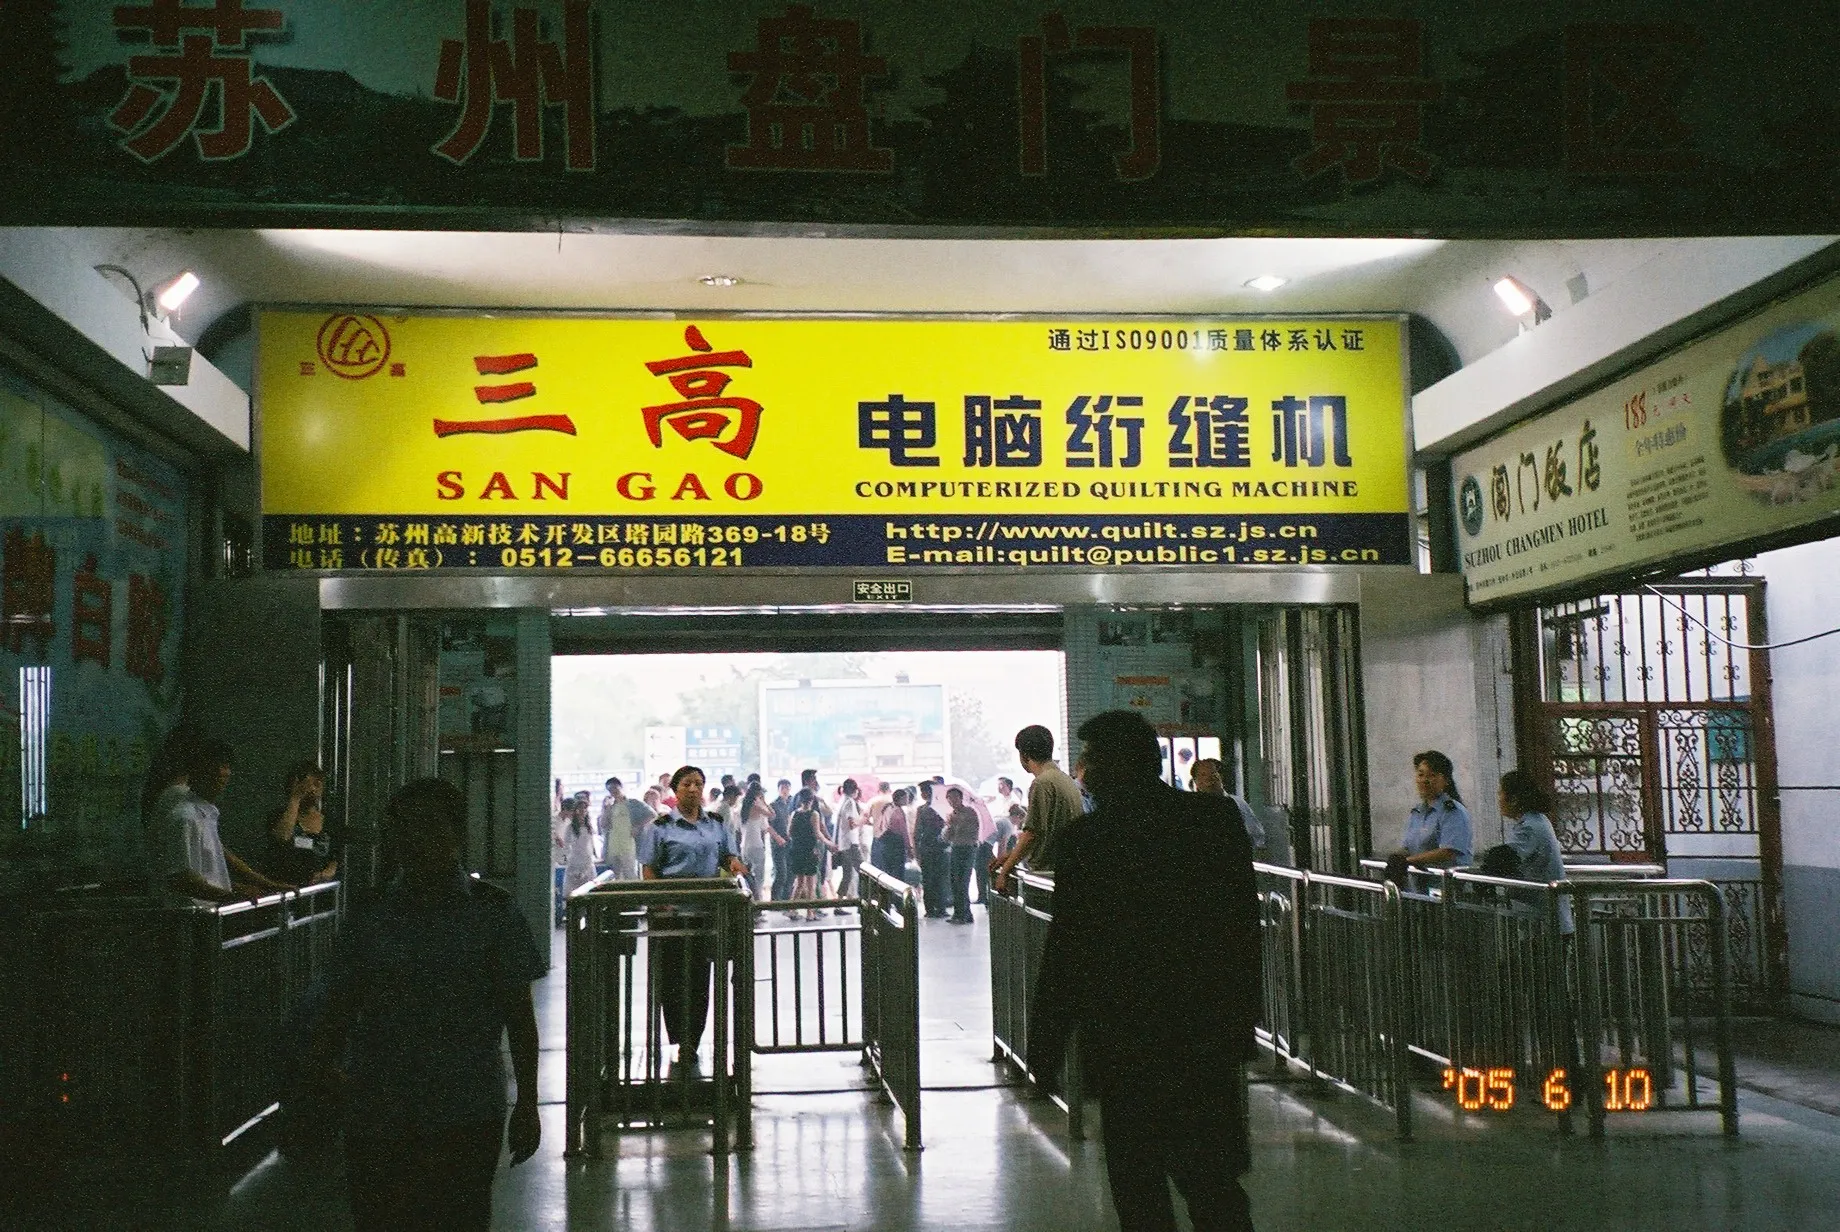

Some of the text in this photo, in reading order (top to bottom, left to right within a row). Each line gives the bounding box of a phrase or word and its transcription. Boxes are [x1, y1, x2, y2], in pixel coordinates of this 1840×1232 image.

[108, 0, 1705, 182] 苏州盘门景区
[1048, 329, 1365, 351] 通过ISO9001质量体系认证
[433, 324, 764, 460] 三高
[857, 393, 1353, 468] 电脑绗缝机
[436, 470, 764, 500] SAN GAO
[855, 480, 1359, 500] COMPUTERIZED QUILTING MACHINE
[886, 521, 1319, 542] http://www.quilt.sz.js.cn
[1464, 543, 1502, 569] SUZHOU
[1506, 521, 1564, 557] CHANGMEN
[1568, 507, 1609, 537] HOTEL
[887, 545, 1380, 565] E-mail:quilt@public1.sz.js.cn
[857, 583, 909, 594] 安全出口
